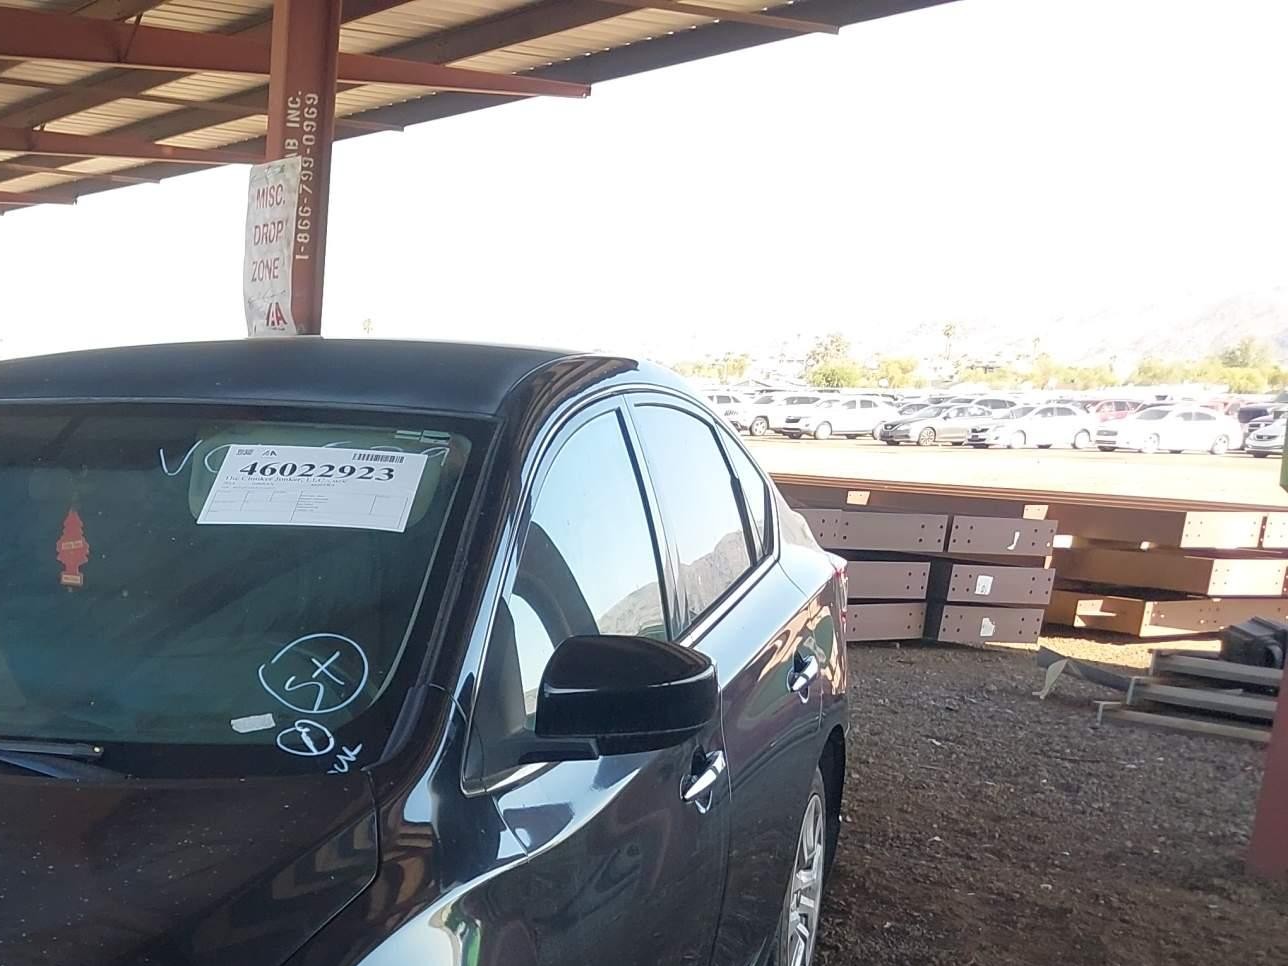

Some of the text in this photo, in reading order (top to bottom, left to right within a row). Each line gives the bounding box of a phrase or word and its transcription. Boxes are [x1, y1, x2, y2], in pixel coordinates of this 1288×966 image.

[286, 91, 301, 128] INC.
[296, 93, 319, 259] 1-866-799-0969
[256, 184, 286, 209] MISC.
[253, 221, 283, 246] DROP
[251, 258, 279, 282] ZONE
[239, 461, 395, 482] 46022923
